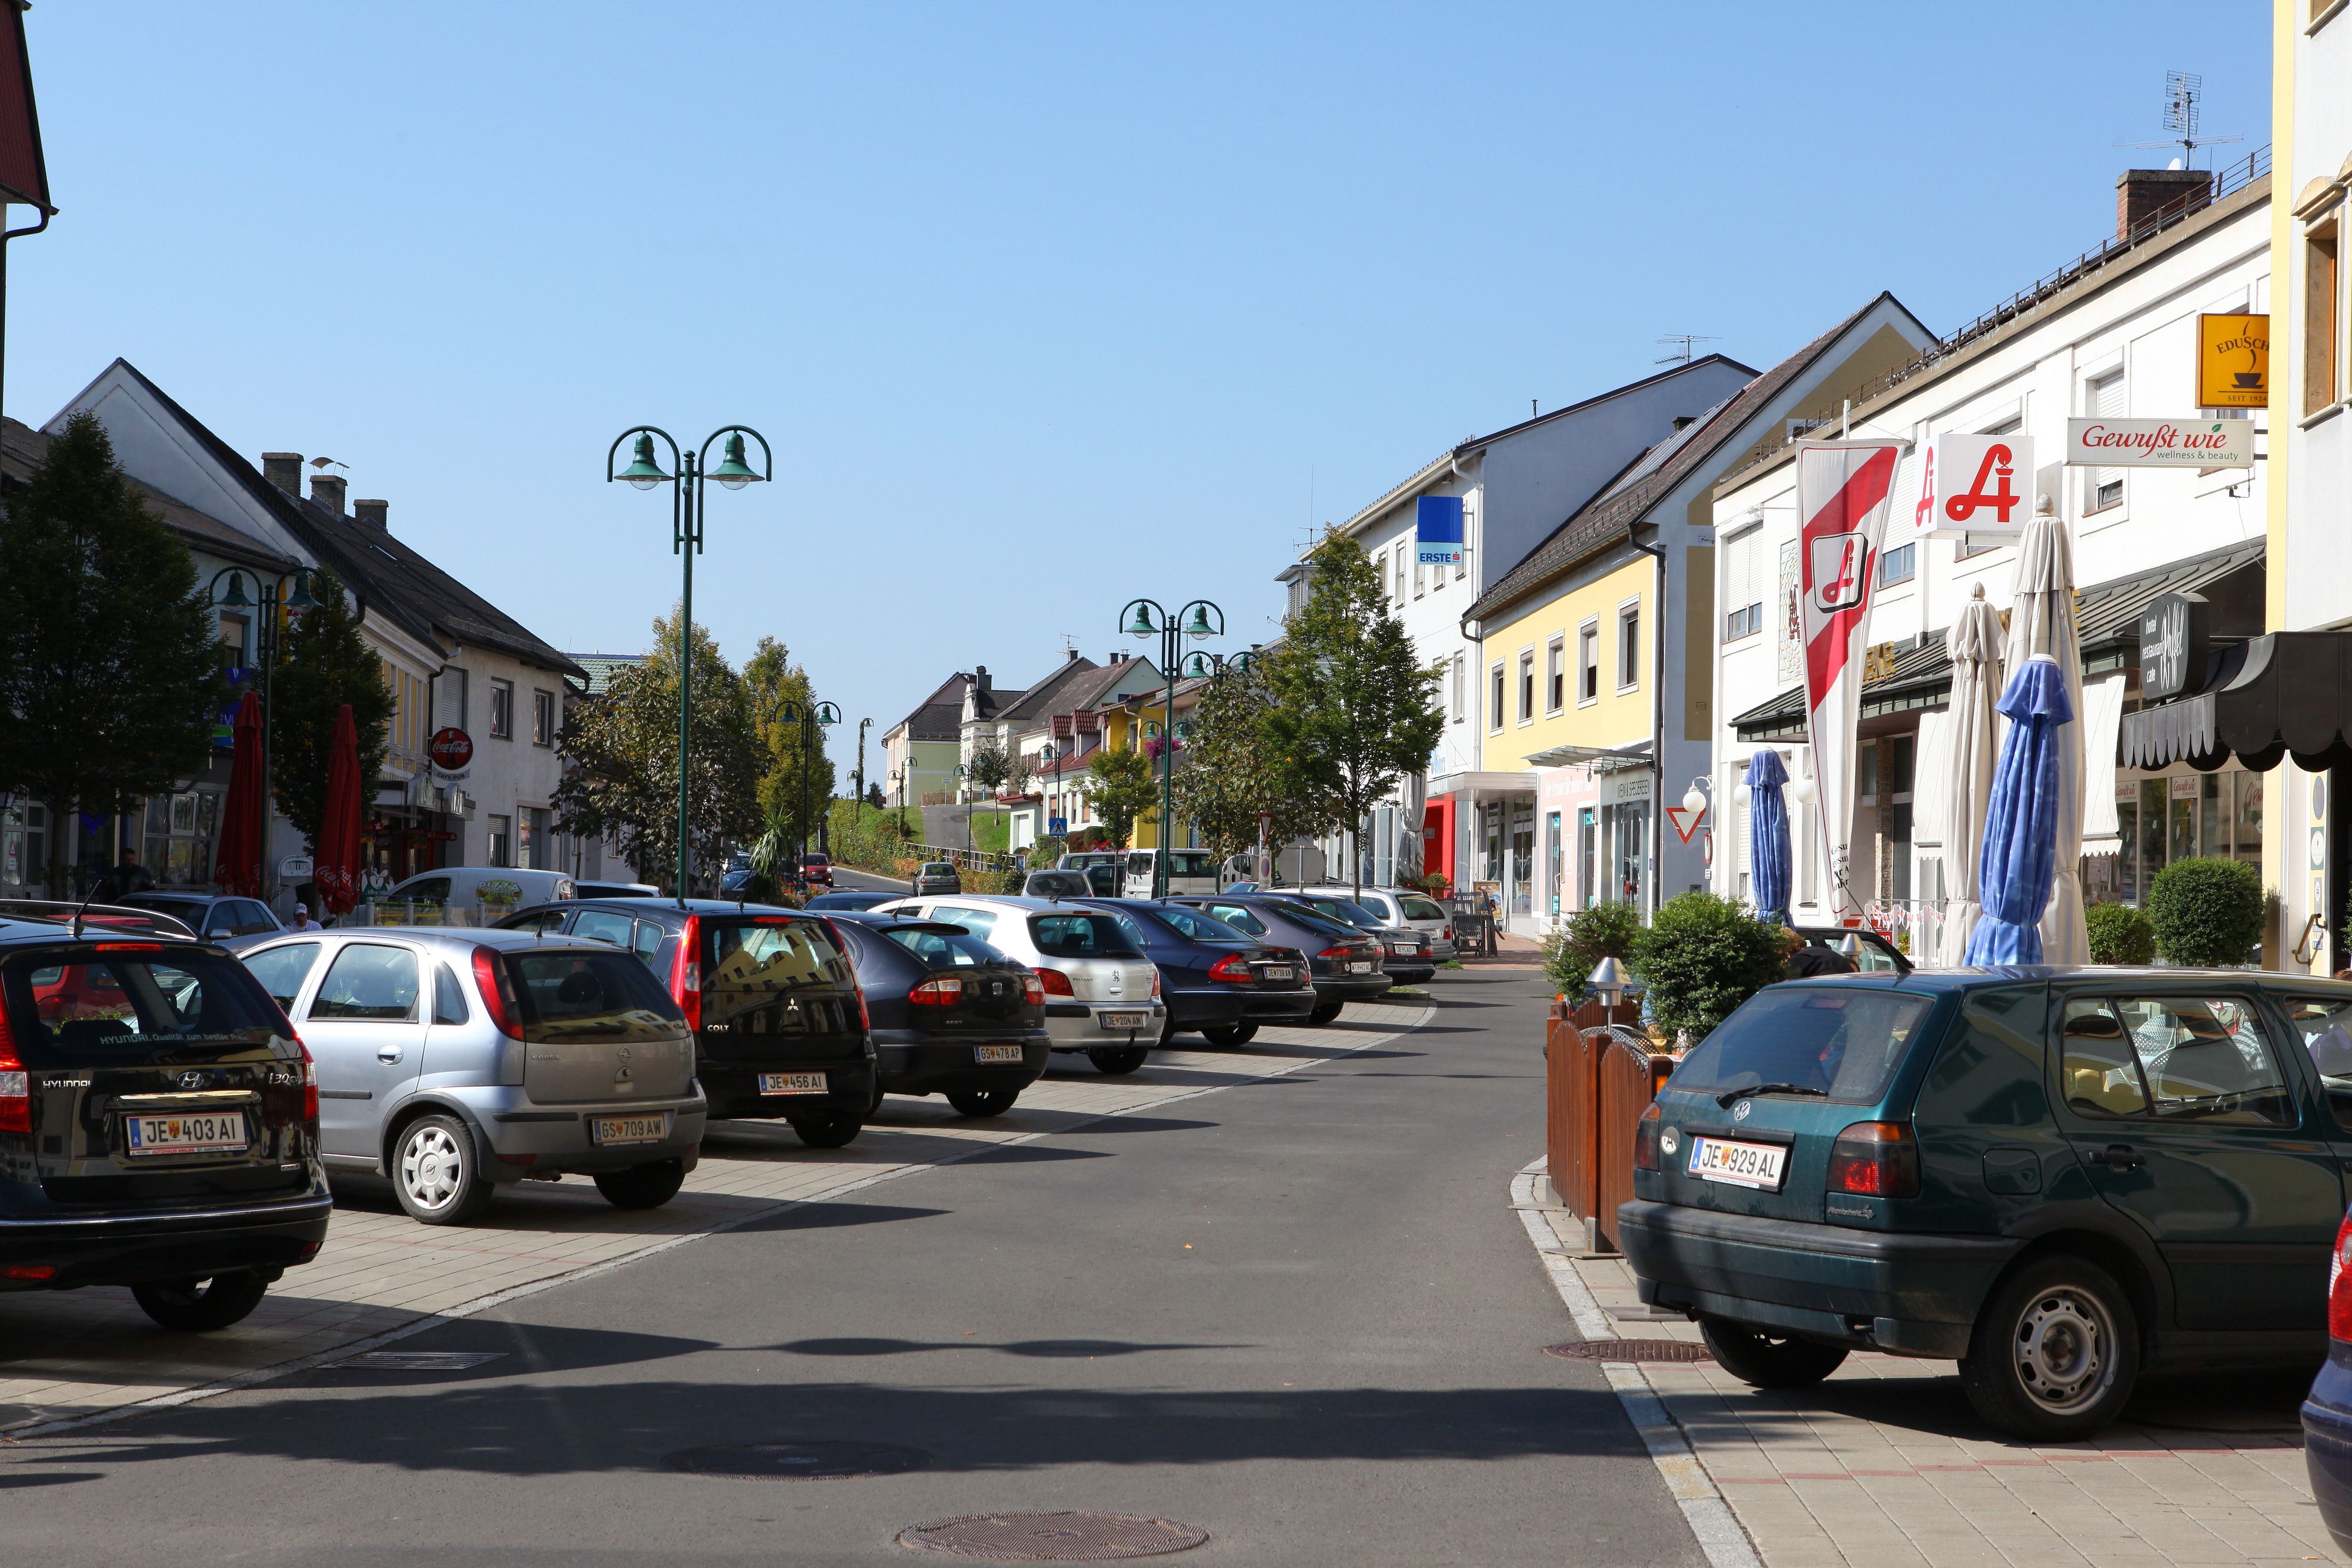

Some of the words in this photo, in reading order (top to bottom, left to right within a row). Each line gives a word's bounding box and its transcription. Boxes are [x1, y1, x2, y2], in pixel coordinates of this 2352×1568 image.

[2082, 424, 2180, 458] Gewußt
[2183, 430, 2227, 449] wie
[2157, 450, 2195, 459] wellness
[2197, 451, 2205, 459] &
[2208, 451, 2239, 462] beauty
[1419, 553, 1451, 563] ERSTE
[2146, 615, 2157, 635] hotel
[2142, 640, 2164, 660] restaurant
[437, 772, 465, 780] CAFE-PUB
[479, 881, 520, 892] PIZZA
[1268, 969, 1274, 977] JE
[1276, 969, 1285, 977] 739
[1107, 1016, 1115, 1025] JE
[1120, 1016, 1131, 1025] 204
[1132, 1017, 1141, 1025] AM
[153, 1033, 183, 1041] Qualität
[981, 1048, 991, 1059] GS
[996, 1048, 1010, 1058] 478
[1011, 1048, 1020, 1059] AP
[42, 1080, 91, 1088] HYUNDAI
[769, 1076, 783, 1089] JE
[790, 1075, 809, 1088] 456
[811, 1075, 822, 1088] AI
[146, 1121, 169, 1143] JE
[182, 1119, 215, 1141] 403
[219, 1118, 235, 1140] AI
[602, 1122, 616, 1138] GS
[624, 1121, 644, 1136] 709
[646, 1119, 662, 1135] AW
[1702, 1144, 1722, 1169] JE
[1729, 1148, 1757, 1174] 929
[1757, 1153, 1775, 1178] AL
